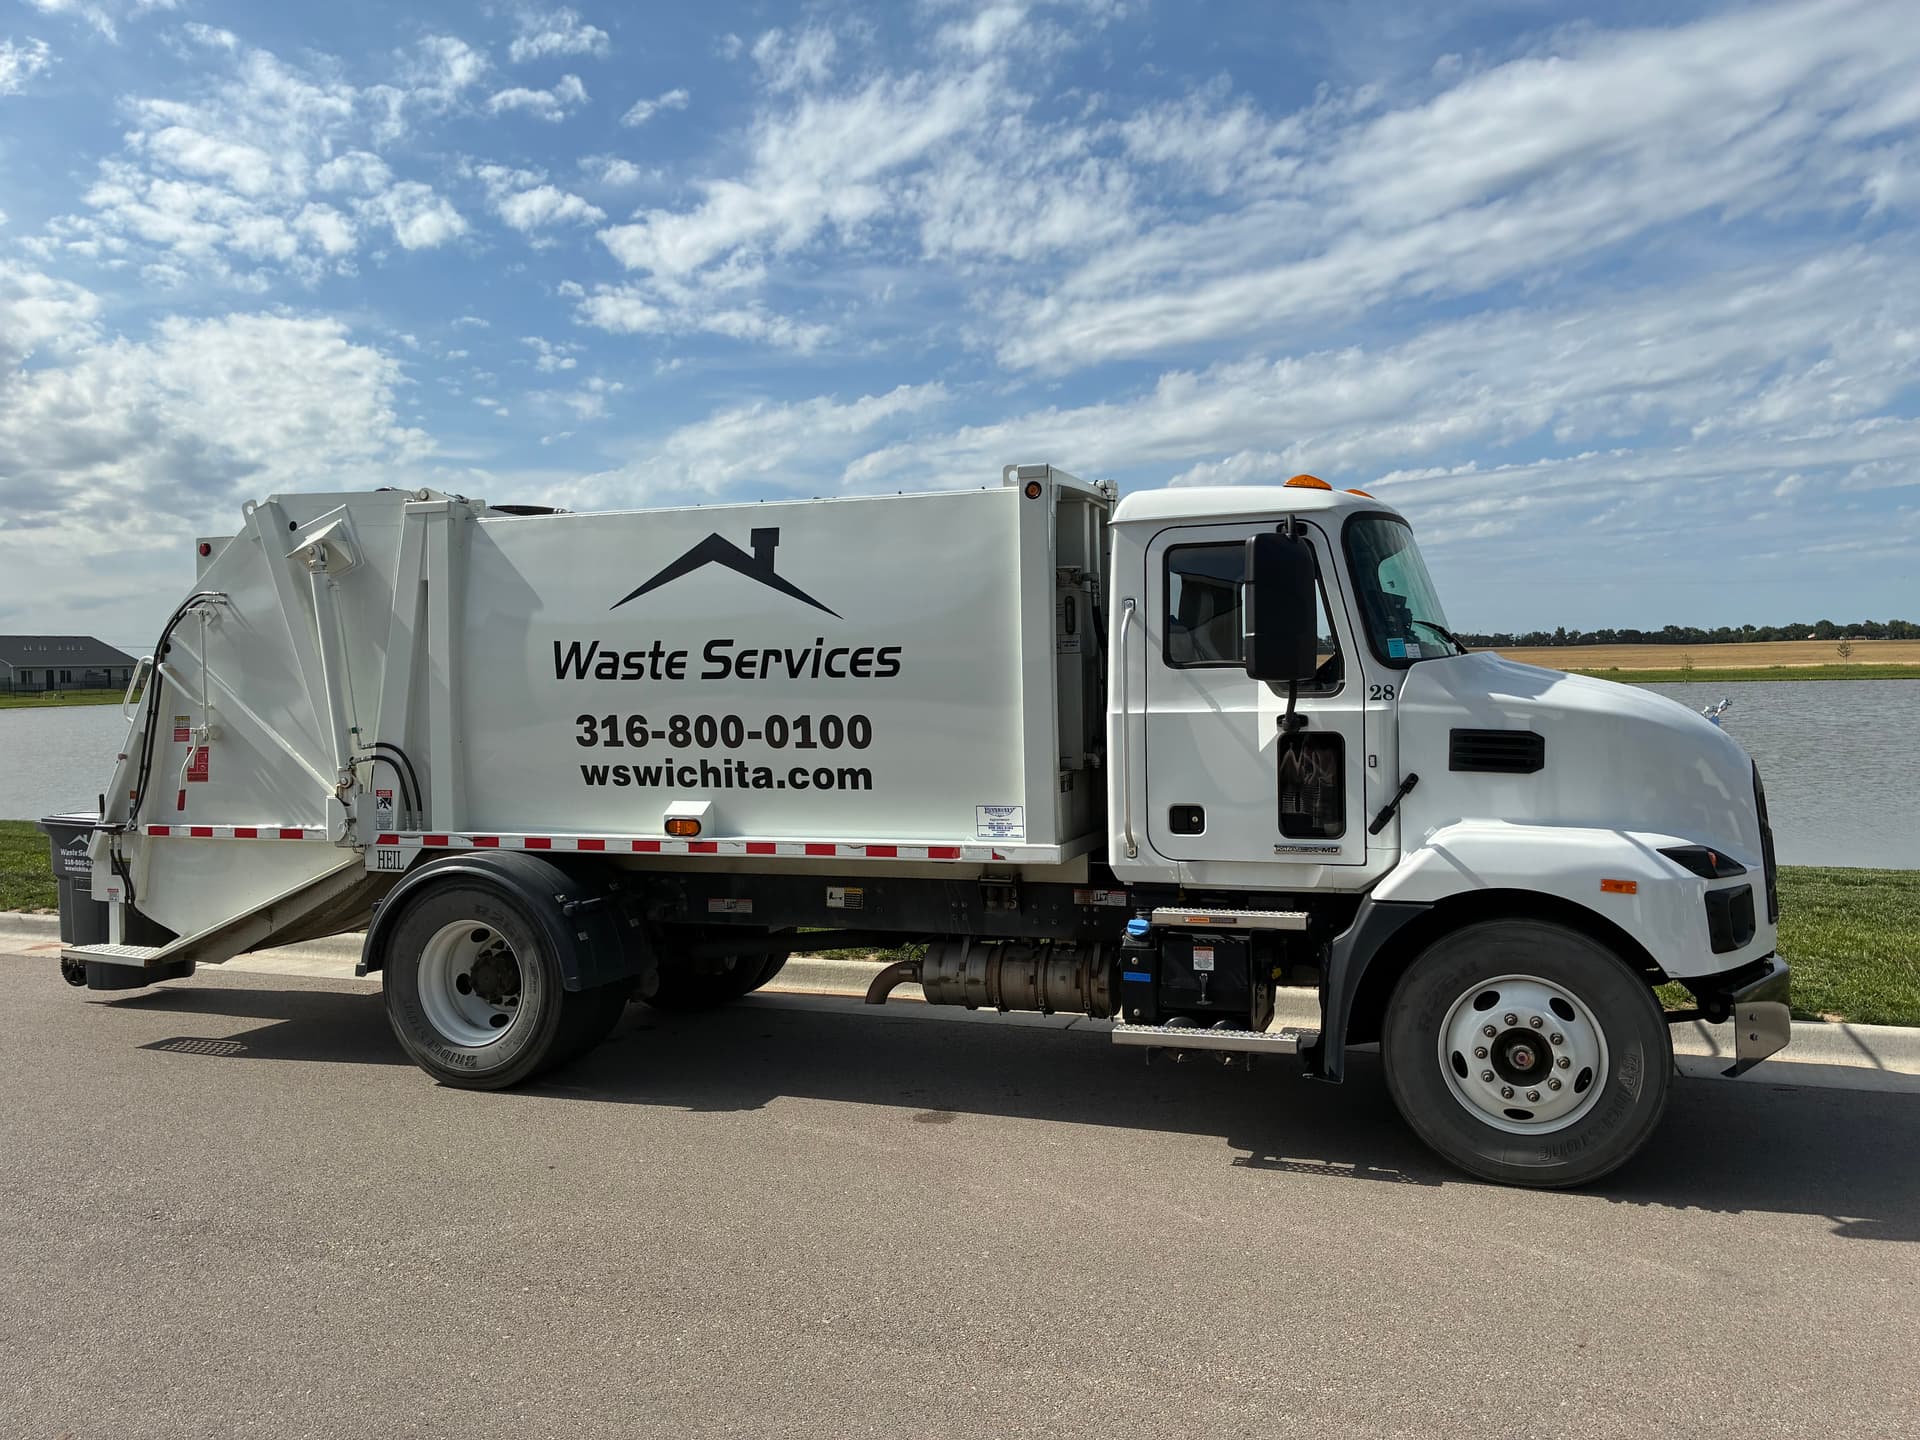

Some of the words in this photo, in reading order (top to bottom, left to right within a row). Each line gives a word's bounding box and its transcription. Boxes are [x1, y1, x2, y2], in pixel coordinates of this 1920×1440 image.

[553, 640, 688, 680] Waste
[701, 637, 902, 680] Services
[1369, 684, 1395, 701] 28
[575, 714, 873, 750] 316-800-0100
[580, 758, 873, 790] wswichita.com
[377, 850, 404, 870] HEIL
